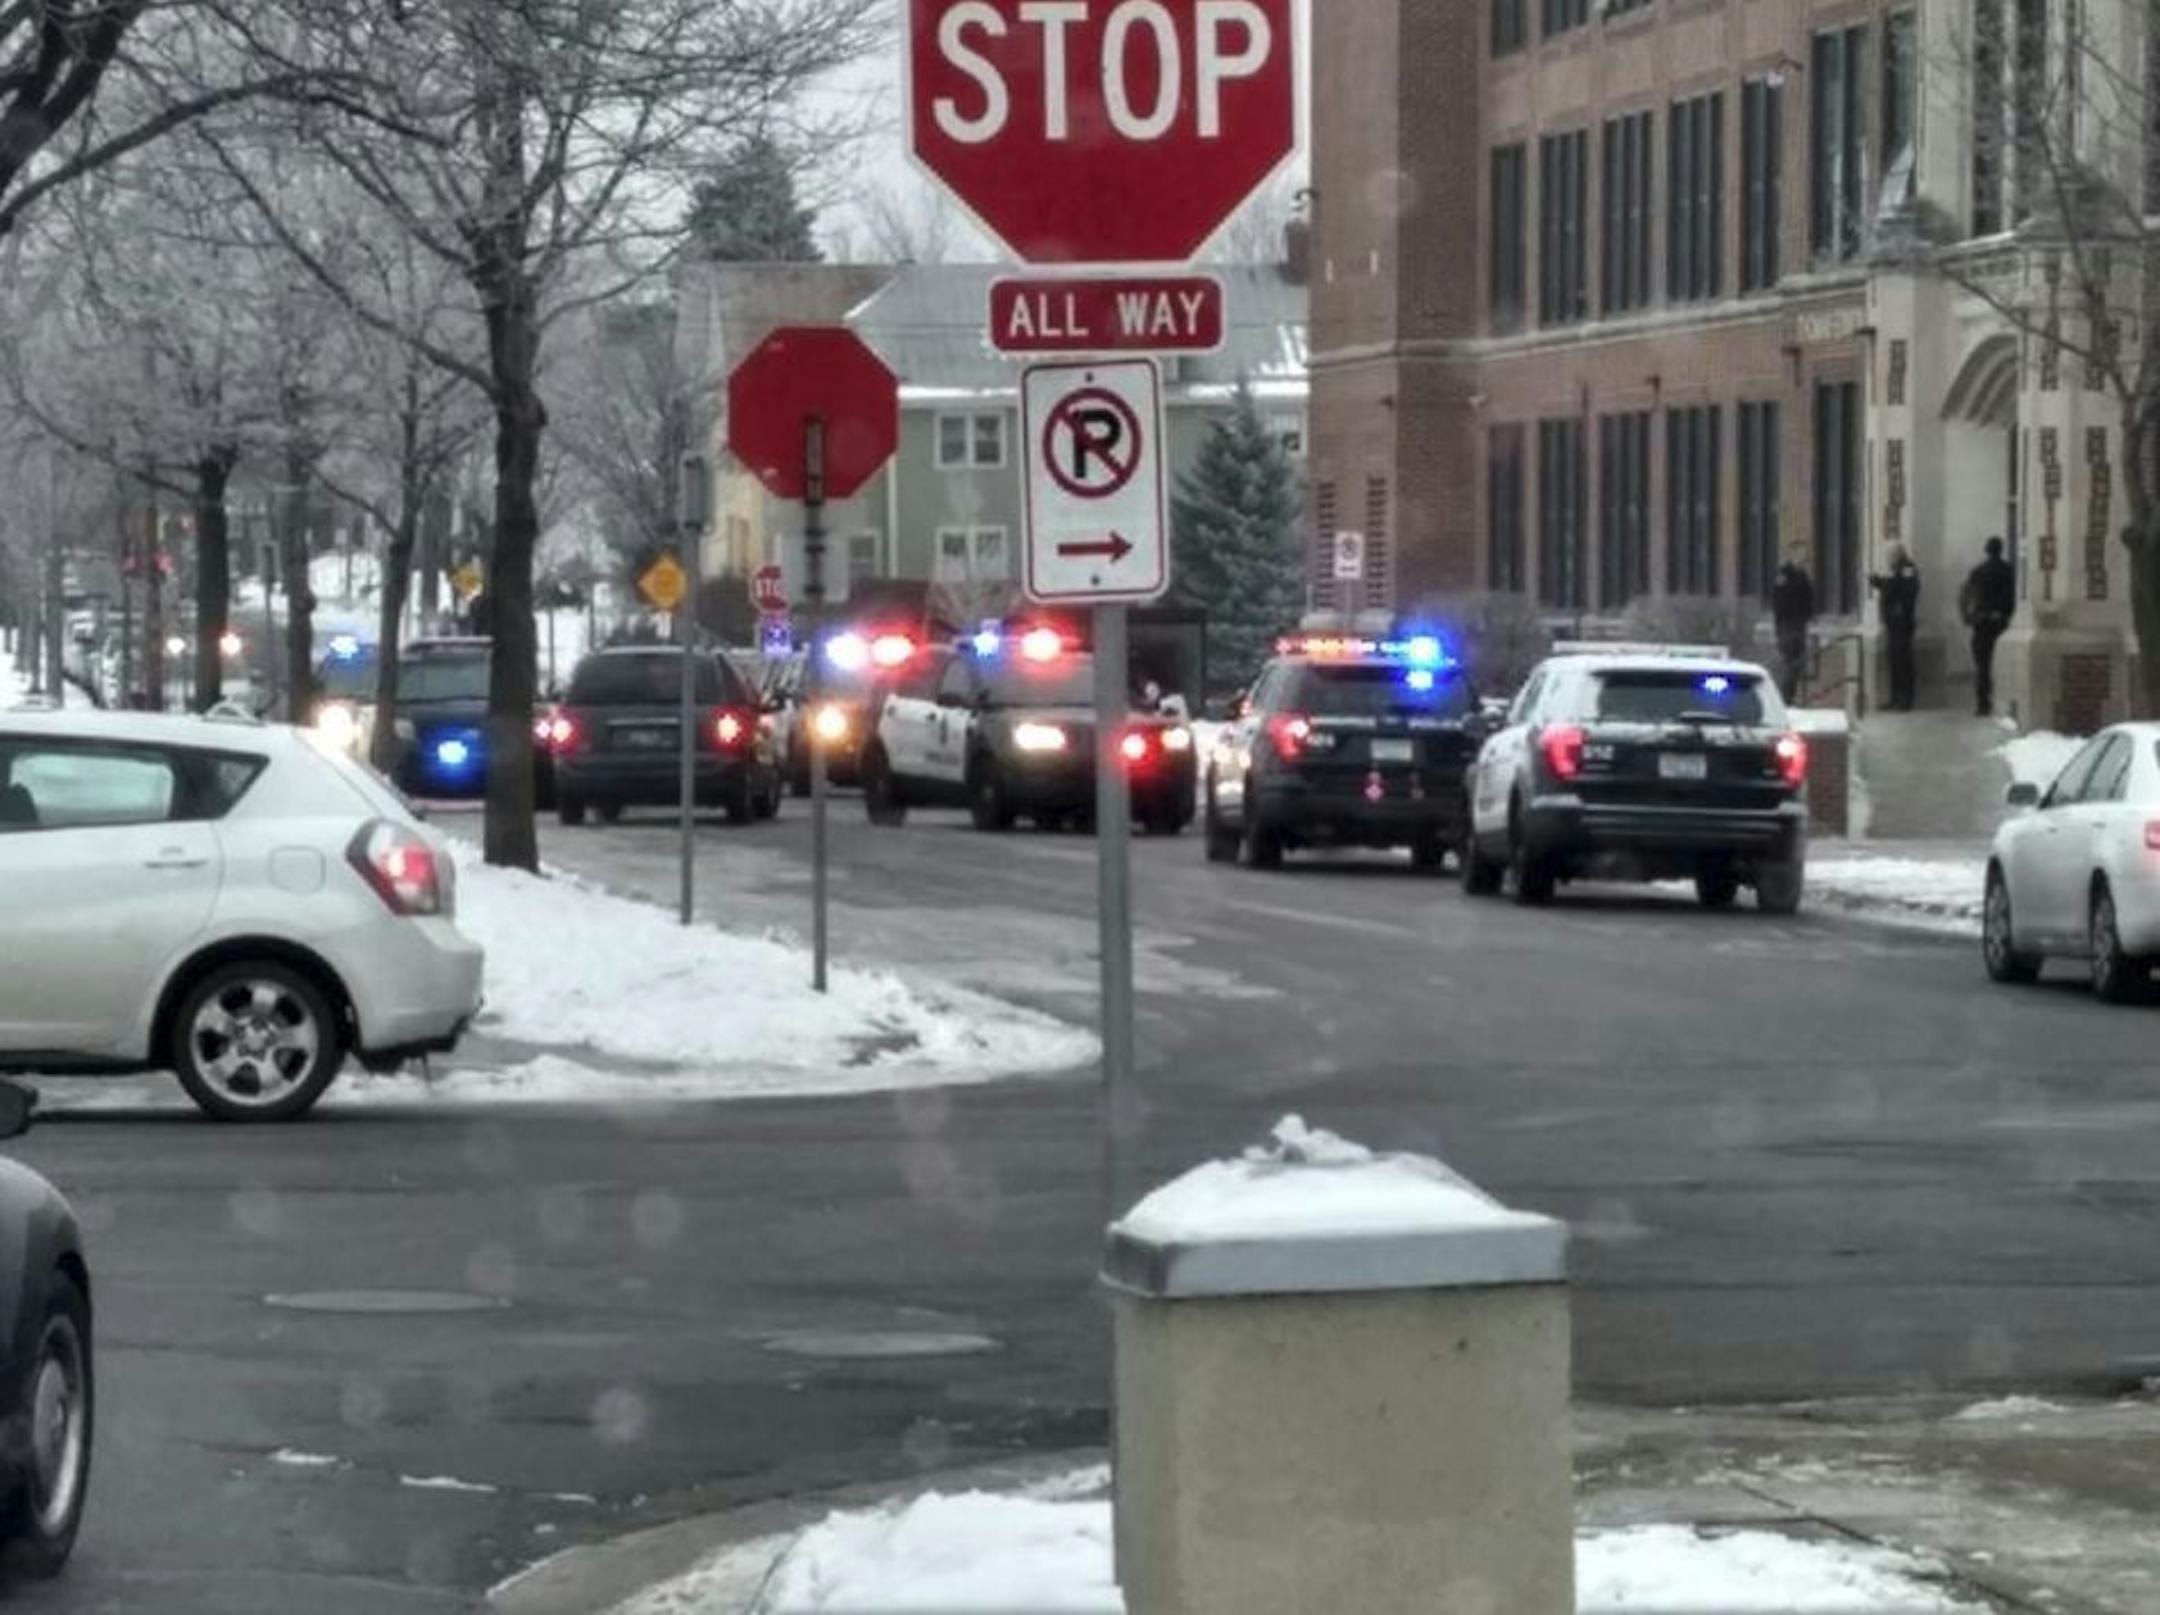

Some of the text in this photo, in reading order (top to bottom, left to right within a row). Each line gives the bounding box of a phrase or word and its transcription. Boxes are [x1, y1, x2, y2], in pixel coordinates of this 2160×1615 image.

[933, 0, 1271, 144] STOP
[1008, 291, 1204, 337] ALL WAY
